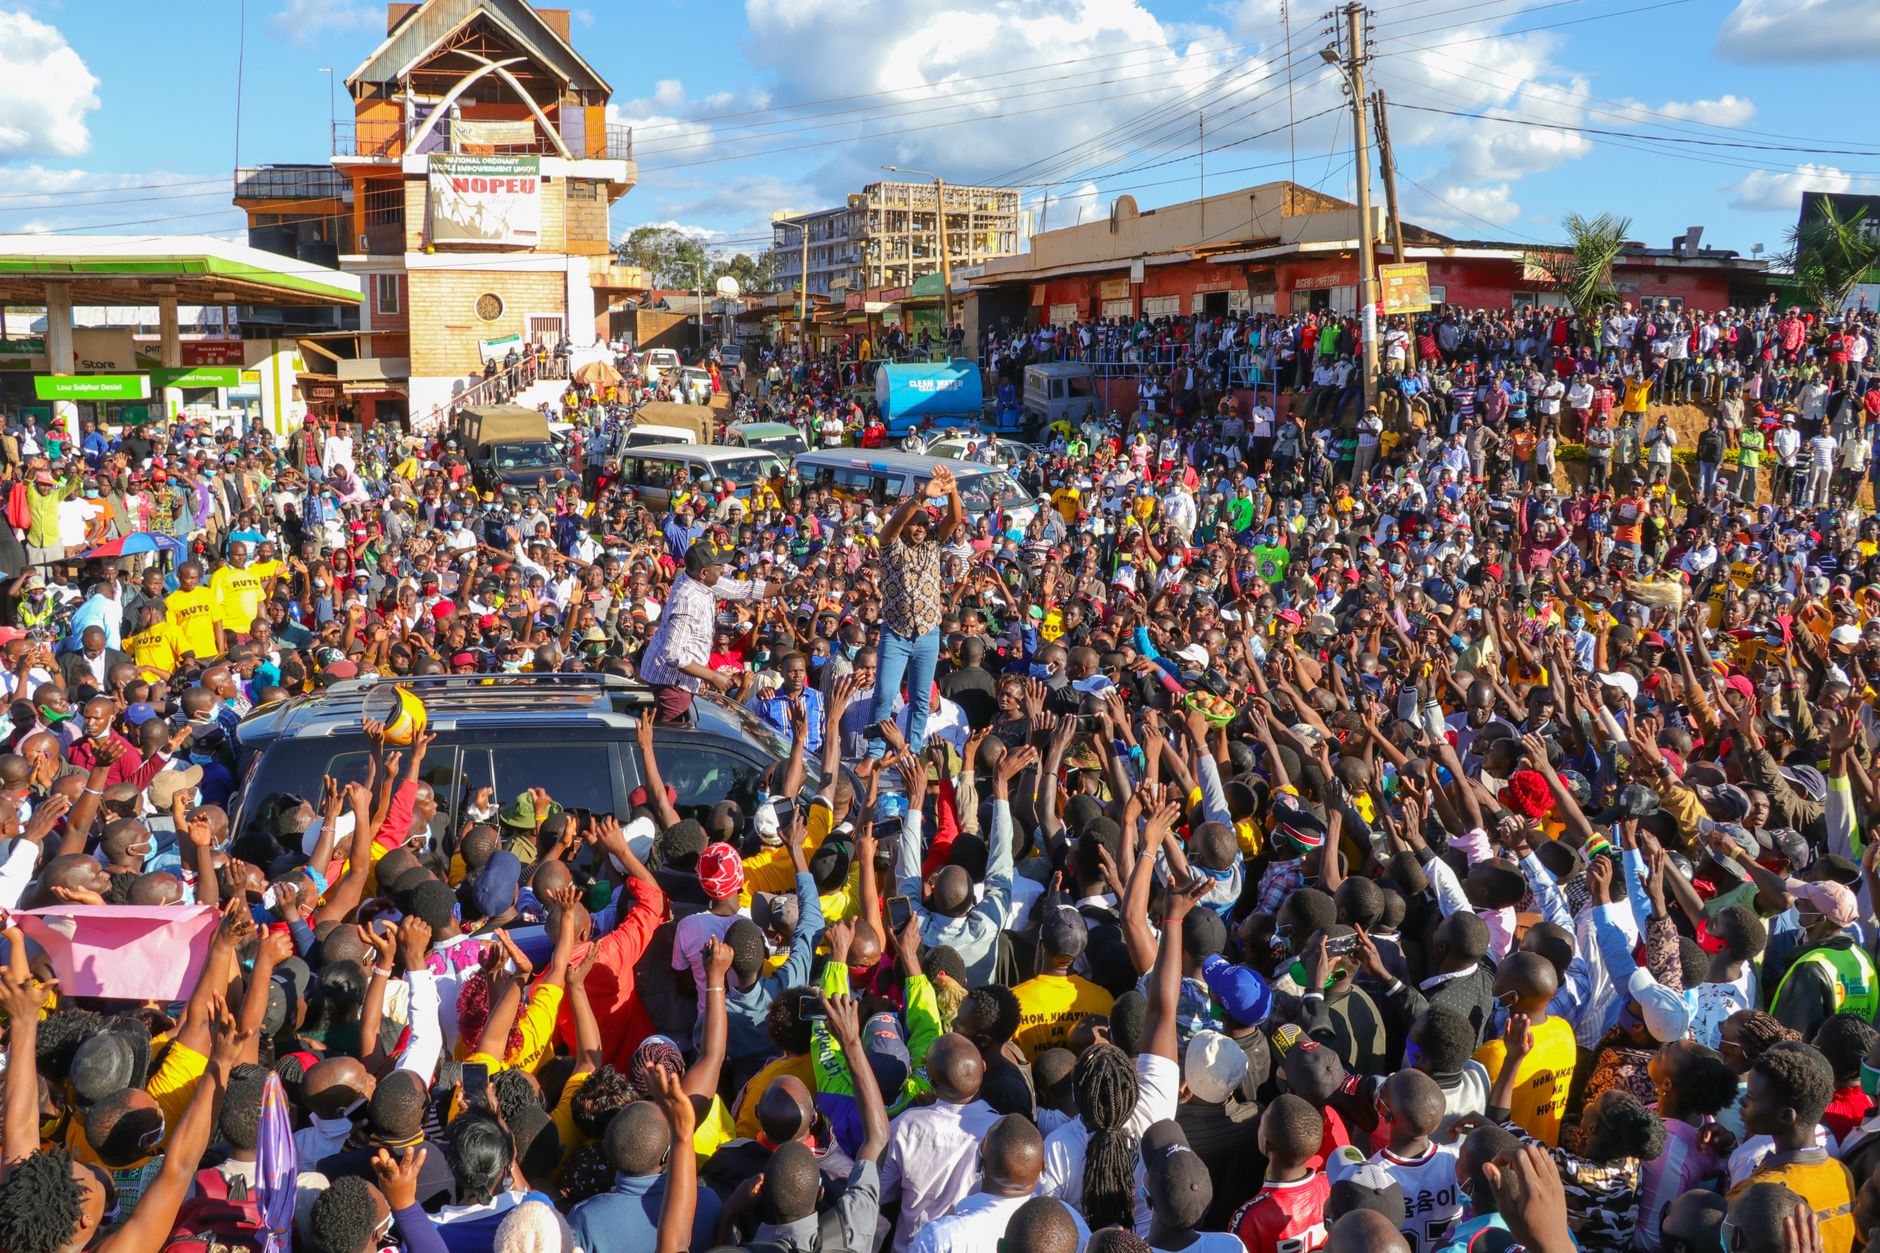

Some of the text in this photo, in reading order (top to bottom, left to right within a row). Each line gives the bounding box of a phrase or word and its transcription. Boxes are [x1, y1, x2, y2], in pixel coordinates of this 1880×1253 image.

[453, 178, 536, 194] NOPEU
[82, 360, 116, 368] Store
[1730, 570, 1752, 578] RUTO
[232, 579, 259, 588] RUTO
[181, 605, 209, 617] RUTO
[1022, 1014, 1048, 1024] HON.
[1533, 1066, 1574, 1088] HON. NKA
